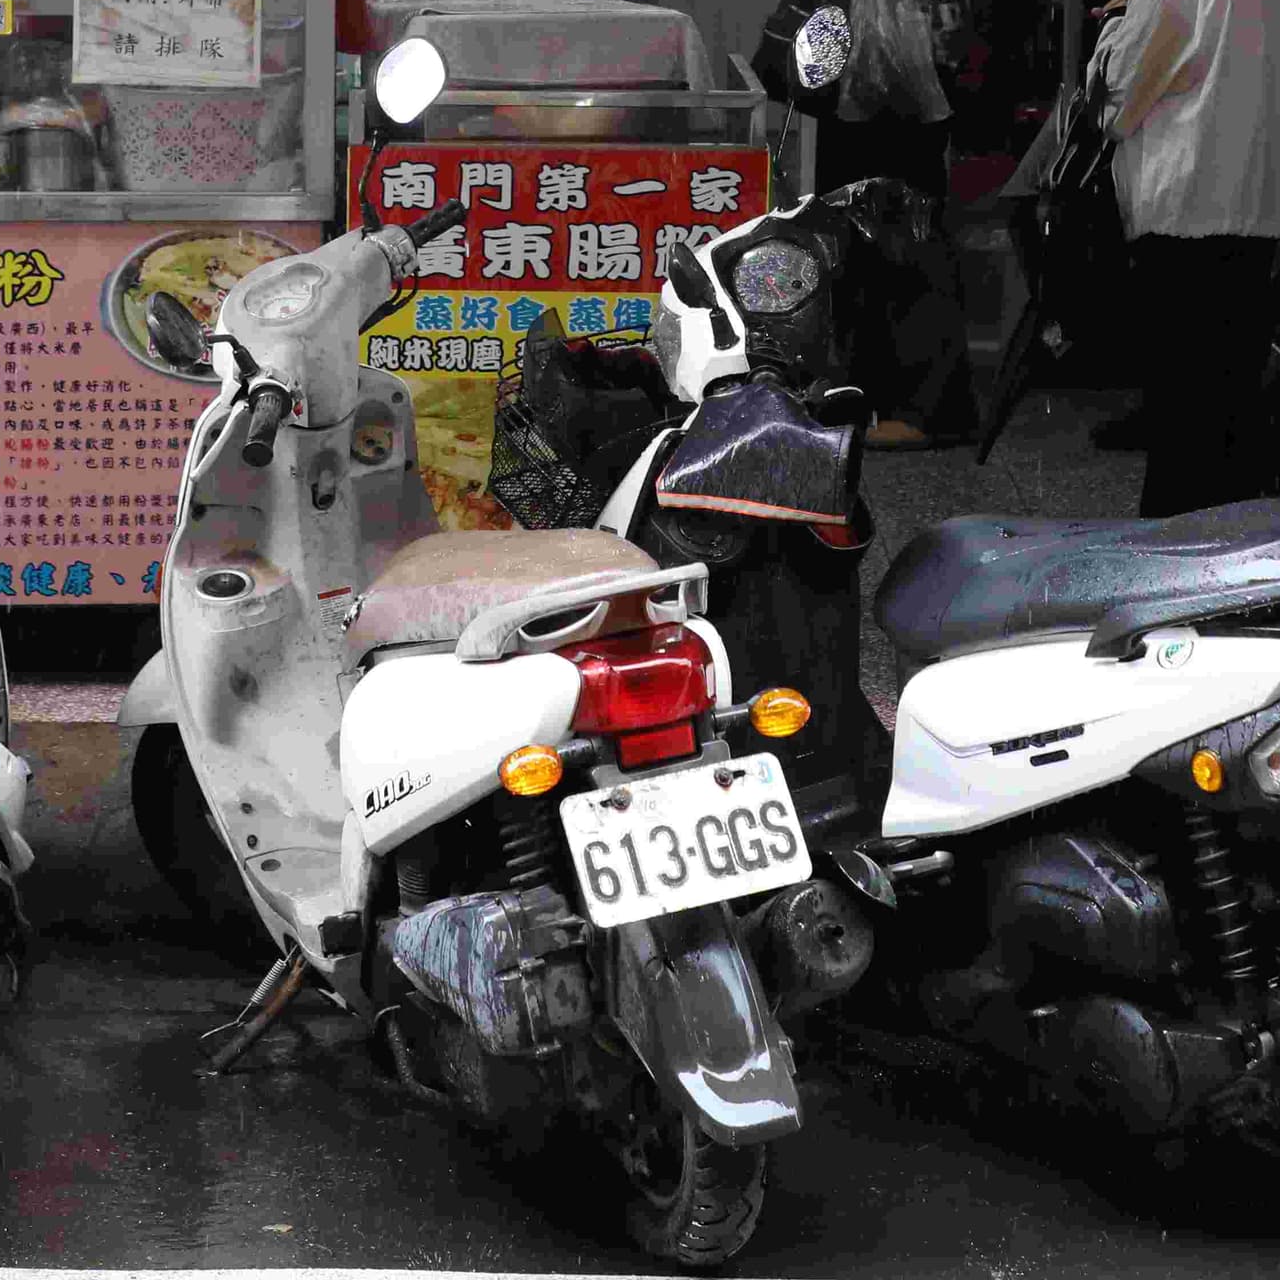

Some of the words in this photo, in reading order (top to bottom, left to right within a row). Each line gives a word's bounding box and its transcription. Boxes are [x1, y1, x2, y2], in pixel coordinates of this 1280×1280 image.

[113, 32, 225, 58] 請排隊
[380, 161, 744, 213] 南門第一家
[367, 335, 504, 372] 純米現磨
